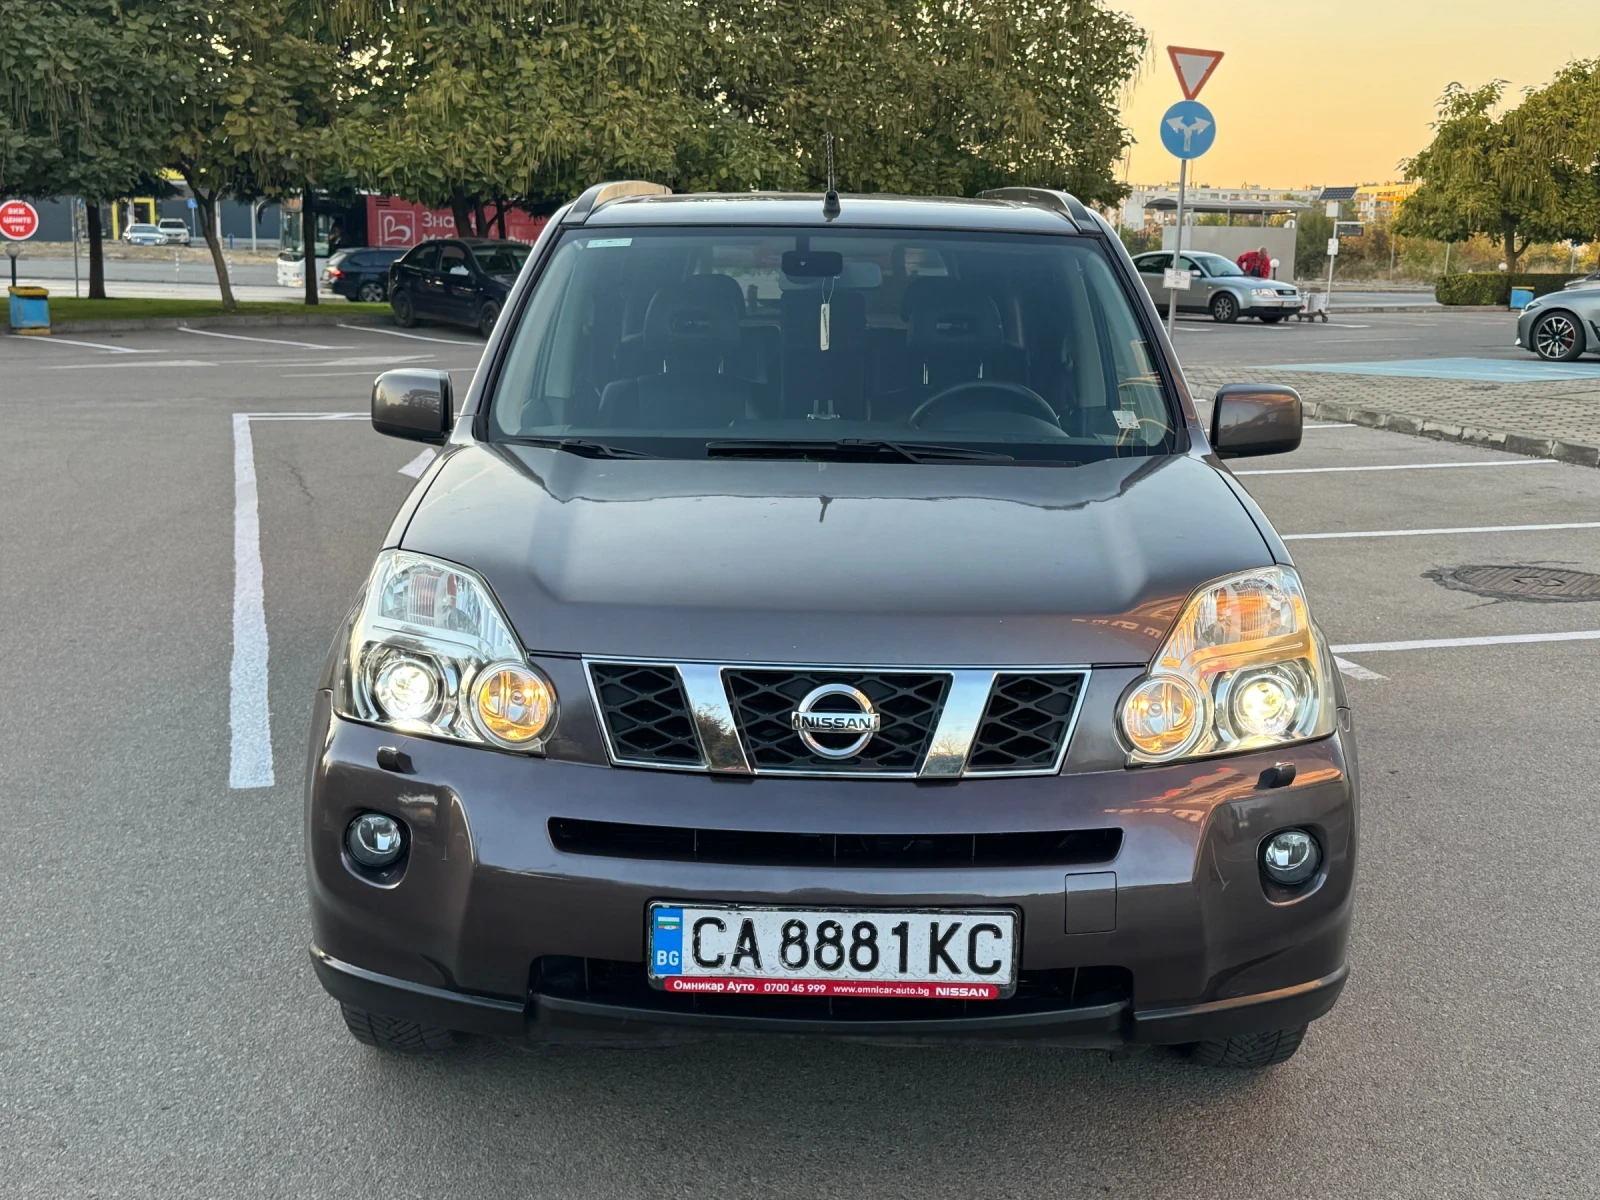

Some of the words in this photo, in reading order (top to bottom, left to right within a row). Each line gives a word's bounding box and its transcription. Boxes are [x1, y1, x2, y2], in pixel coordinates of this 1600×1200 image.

[801, 716, 871, 729] NISSAN
[692, 916, 763, 970] CA
[778, 918, 909, 974] 8881
[928, 921, 1003, 976] KC
[657, 950, 679, 966] BG
[673, 980, 723, 991] Омникар
[727, 981, 755, 992] Ауто
[764, 983, 789, 992] 0700
[791, 984, 804, 993] 45
[807, 984, 826, 994] 999
[833, 985, 930, 997] www.omnicar-auto.bg
[935, 987, 989, 997] NISSAN
